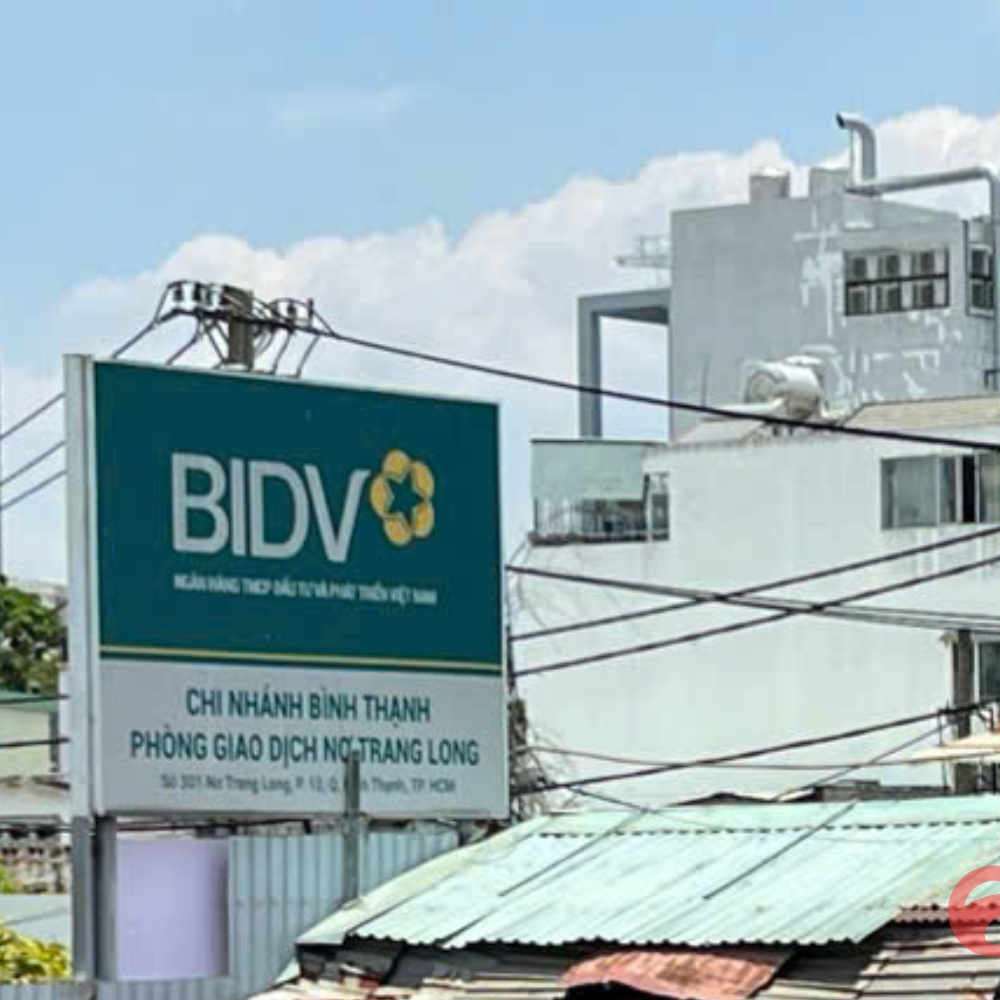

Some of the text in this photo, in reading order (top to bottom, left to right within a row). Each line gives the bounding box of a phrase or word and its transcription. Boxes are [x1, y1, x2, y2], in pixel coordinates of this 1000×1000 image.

[172, 452, 371, 563] BIDV
[186, 683, 431, 728] CHI NHÁNH BÌNH THẠNH
[130, 723, 207, 760] PHÒNG
[214, 732, 263, 762] GIAO
[269, 734, 318, 769] DỊCH
[358, 736, 423, 765] TRANG
[428, 738, 479, 766] LONG
